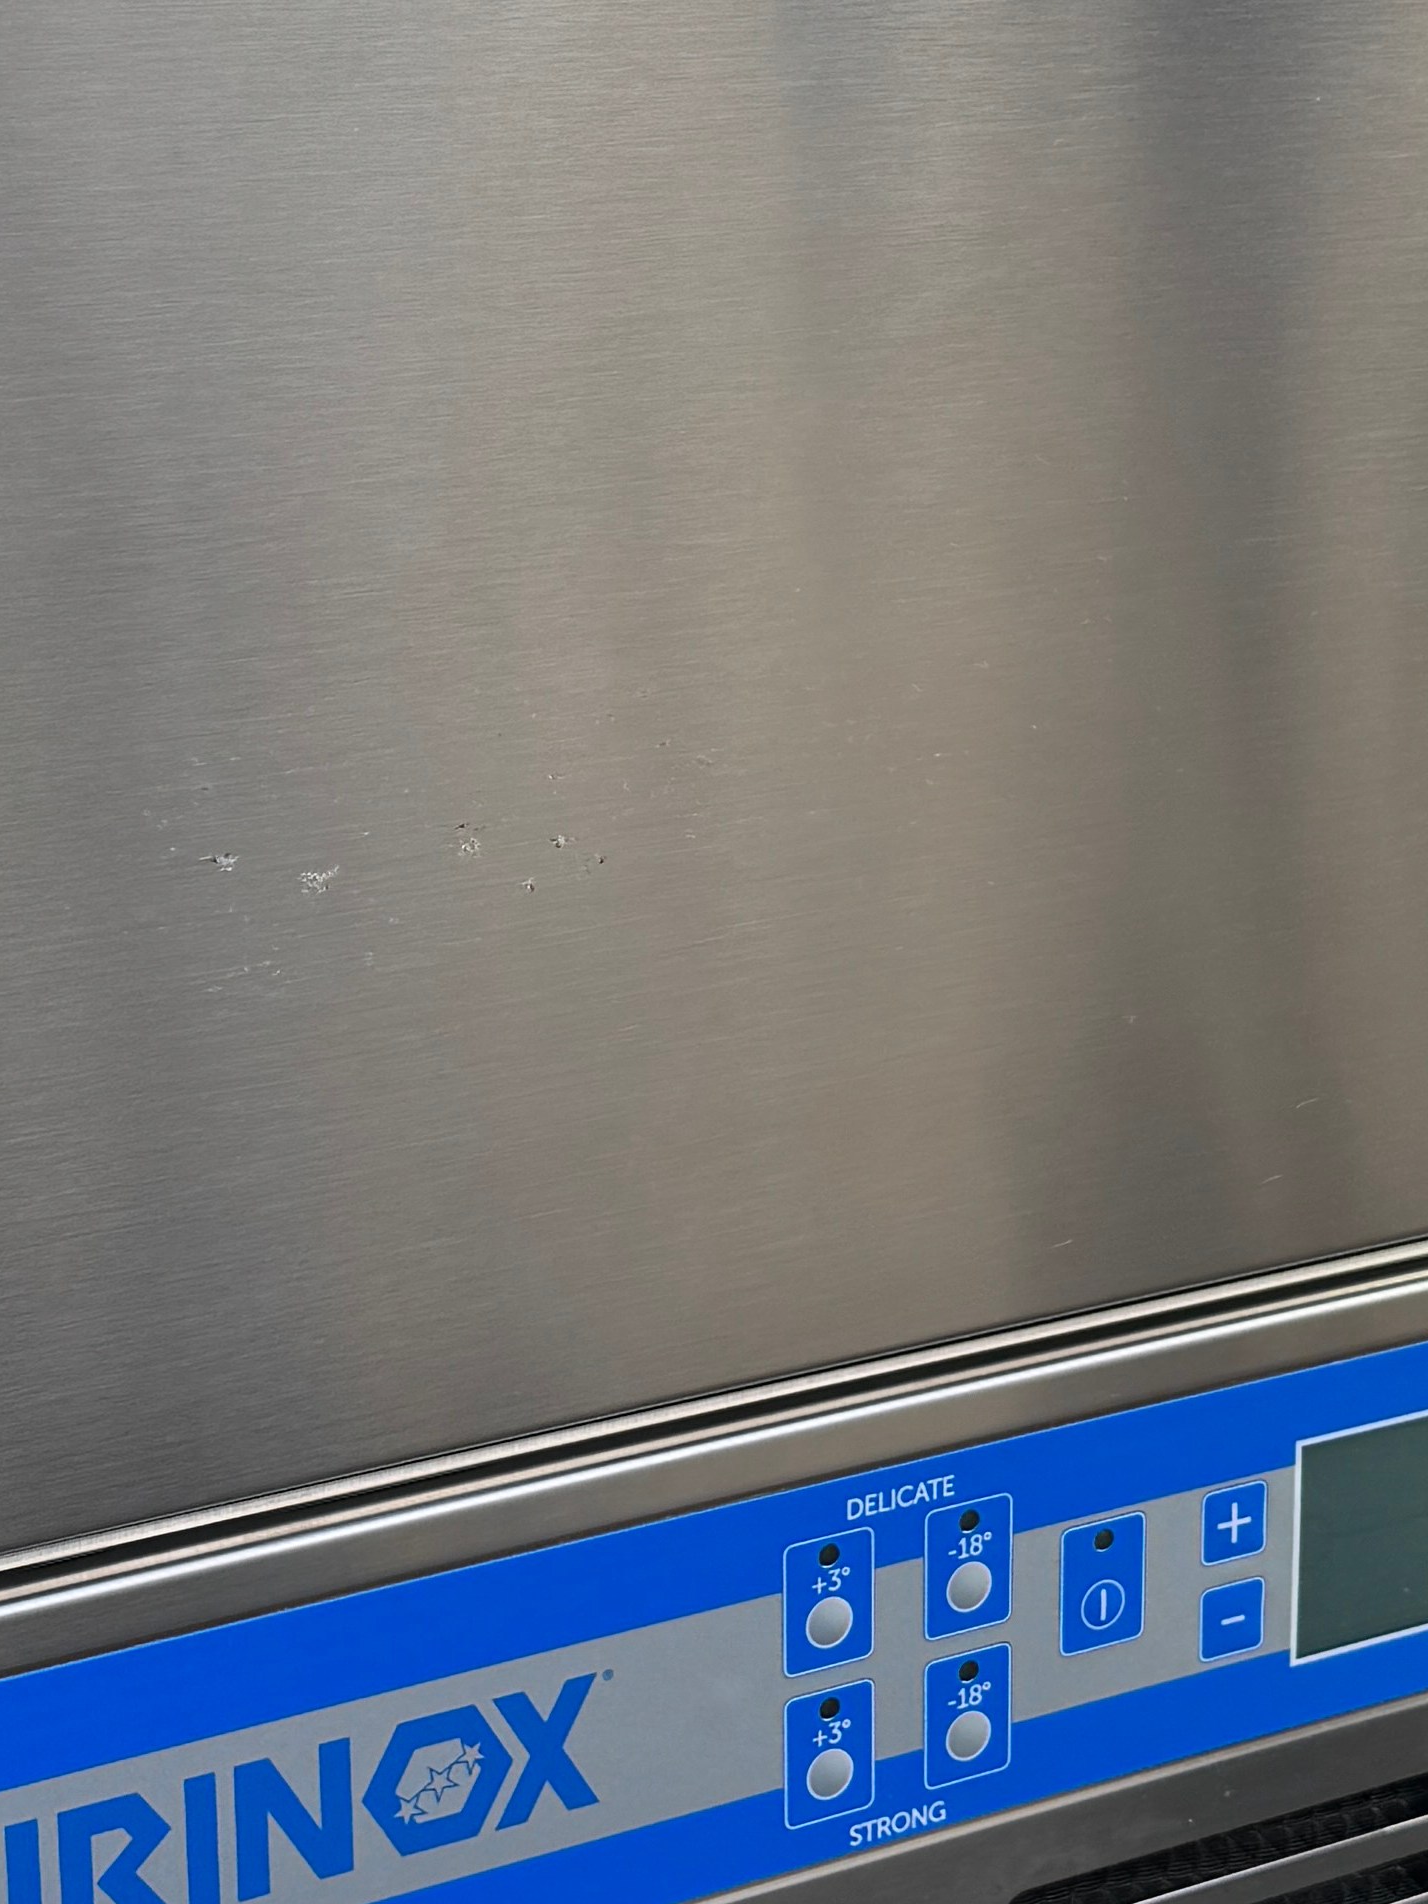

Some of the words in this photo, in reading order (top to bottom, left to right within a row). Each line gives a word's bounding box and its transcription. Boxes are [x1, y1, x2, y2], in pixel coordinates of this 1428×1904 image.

[846, 1475, 956, 1521] DELICATE
[812, 1566, 851, 1593] +3°
[812, 1719, 852, 1746] +3°
[849, 1801, 947, 1847] STRONG
